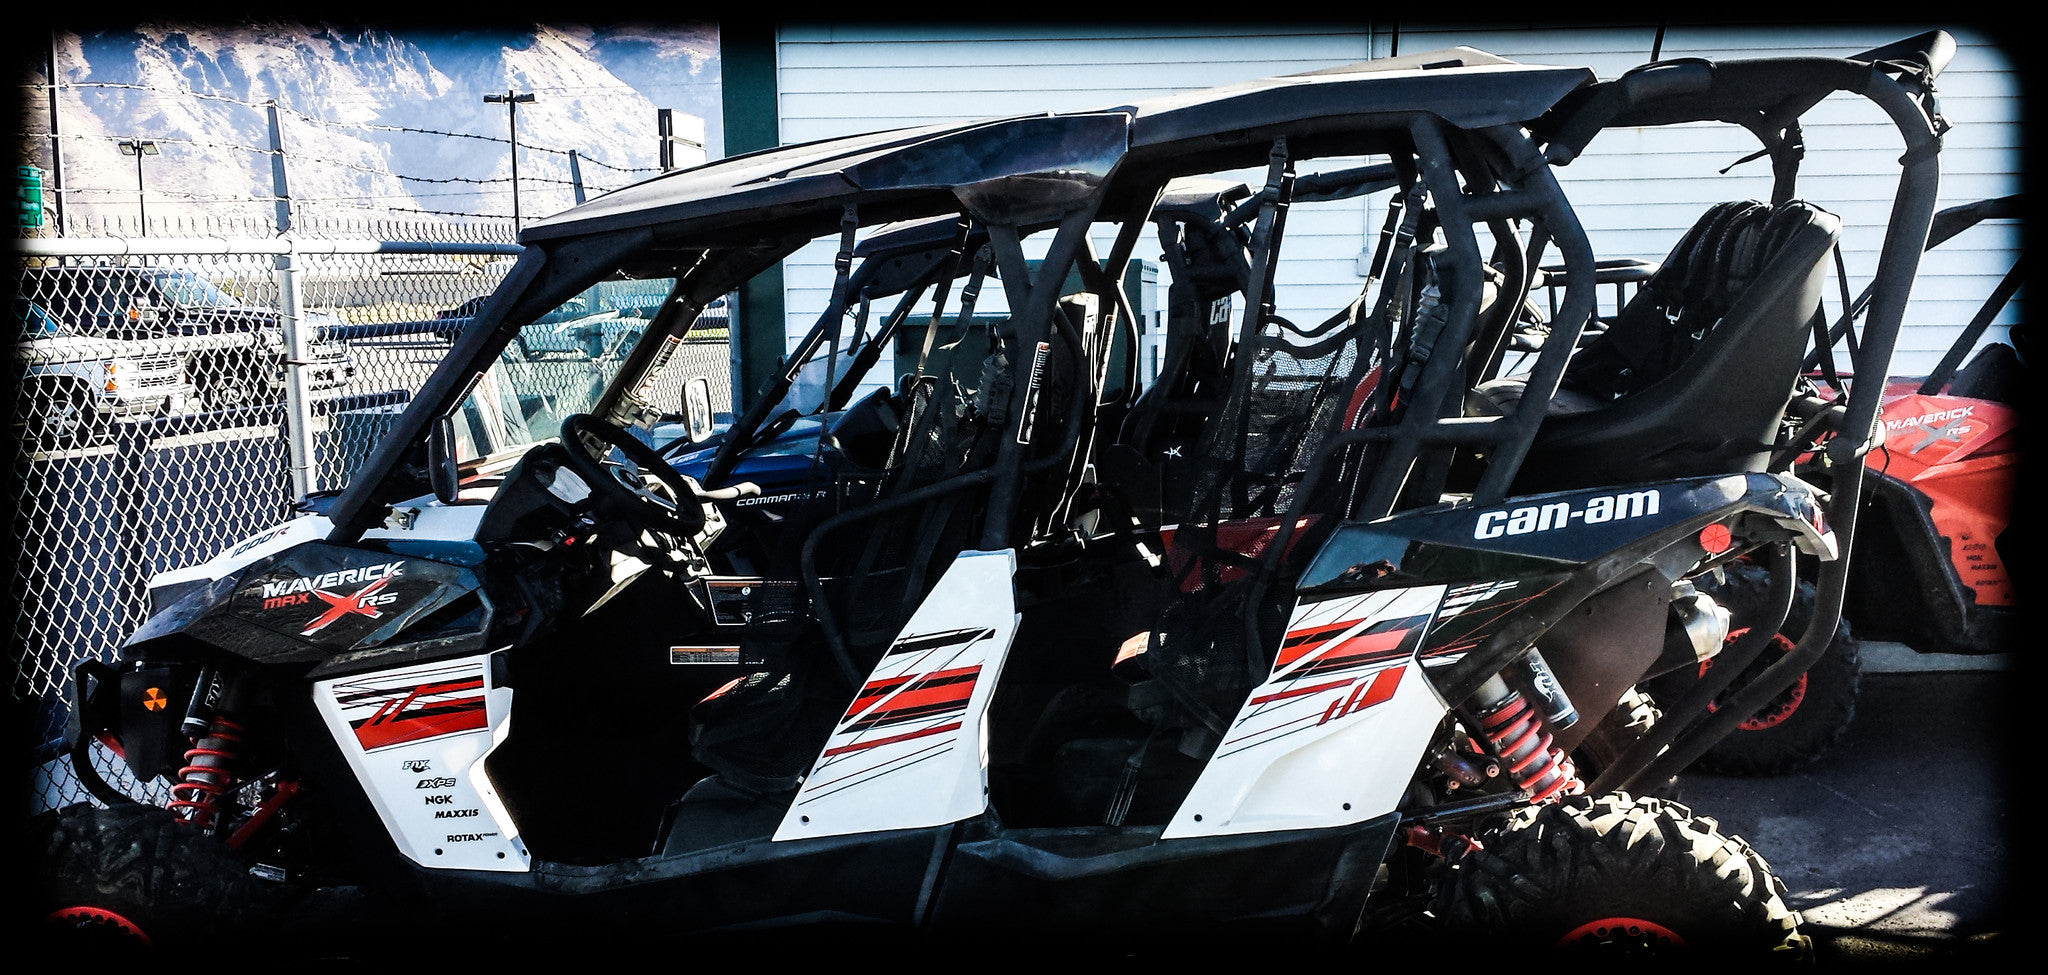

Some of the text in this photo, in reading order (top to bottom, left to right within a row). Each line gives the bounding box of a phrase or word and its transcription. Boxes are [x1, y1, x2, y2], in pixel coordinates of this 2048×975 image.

[1887, 406, 1975, 431] MAVERICK
[736, 490, 826, 506] COMMANR
[1474, 489, 1660, 540] can-am
[231, 526, 290, 558] 1000R
[262, 561, 405, 599] MAVERICK
[264, 592, 310, 610] MAX
[402, 760, 431, 773] FOX
[425, 795, 453, 805] NGK
[435, 809, 479, 819] MAXXIS
[447, 833, 483, 843] ROTAX
